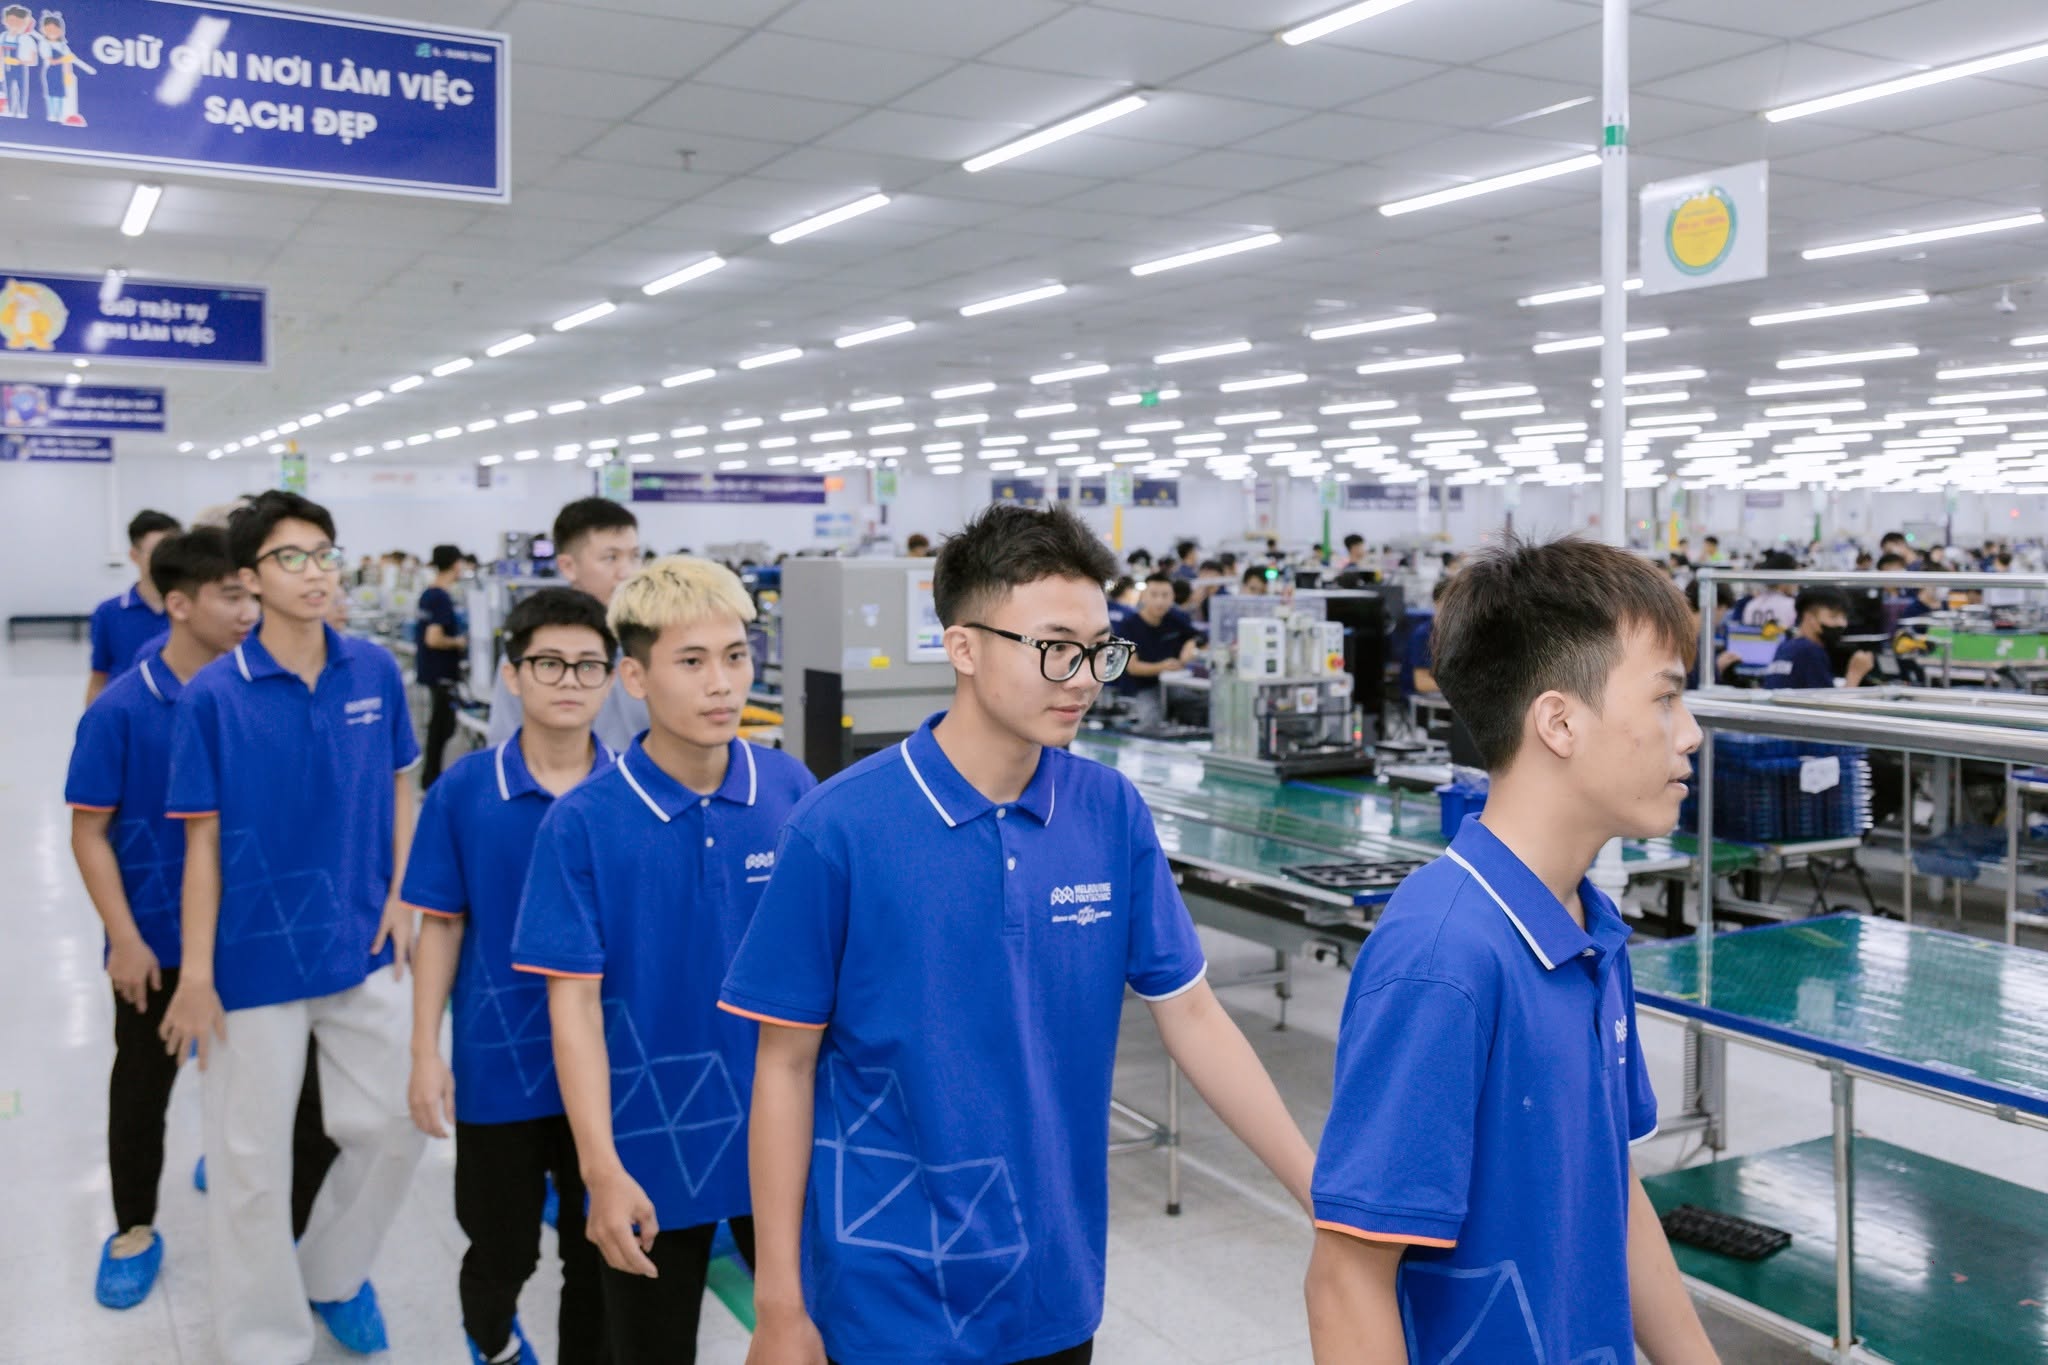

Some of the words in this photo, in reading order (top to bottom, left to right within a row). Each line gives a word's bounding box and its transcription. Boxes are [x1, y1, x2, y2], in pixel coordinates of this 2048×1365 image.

[246, 53, 313, 88] NƠI
[320, 57, 391, 97] LÀM
[398, 69, 475, 111] VIỆC
[204, 95, 305, 134] SẠCH
[312, 106, 379, 146] ĐẸP
